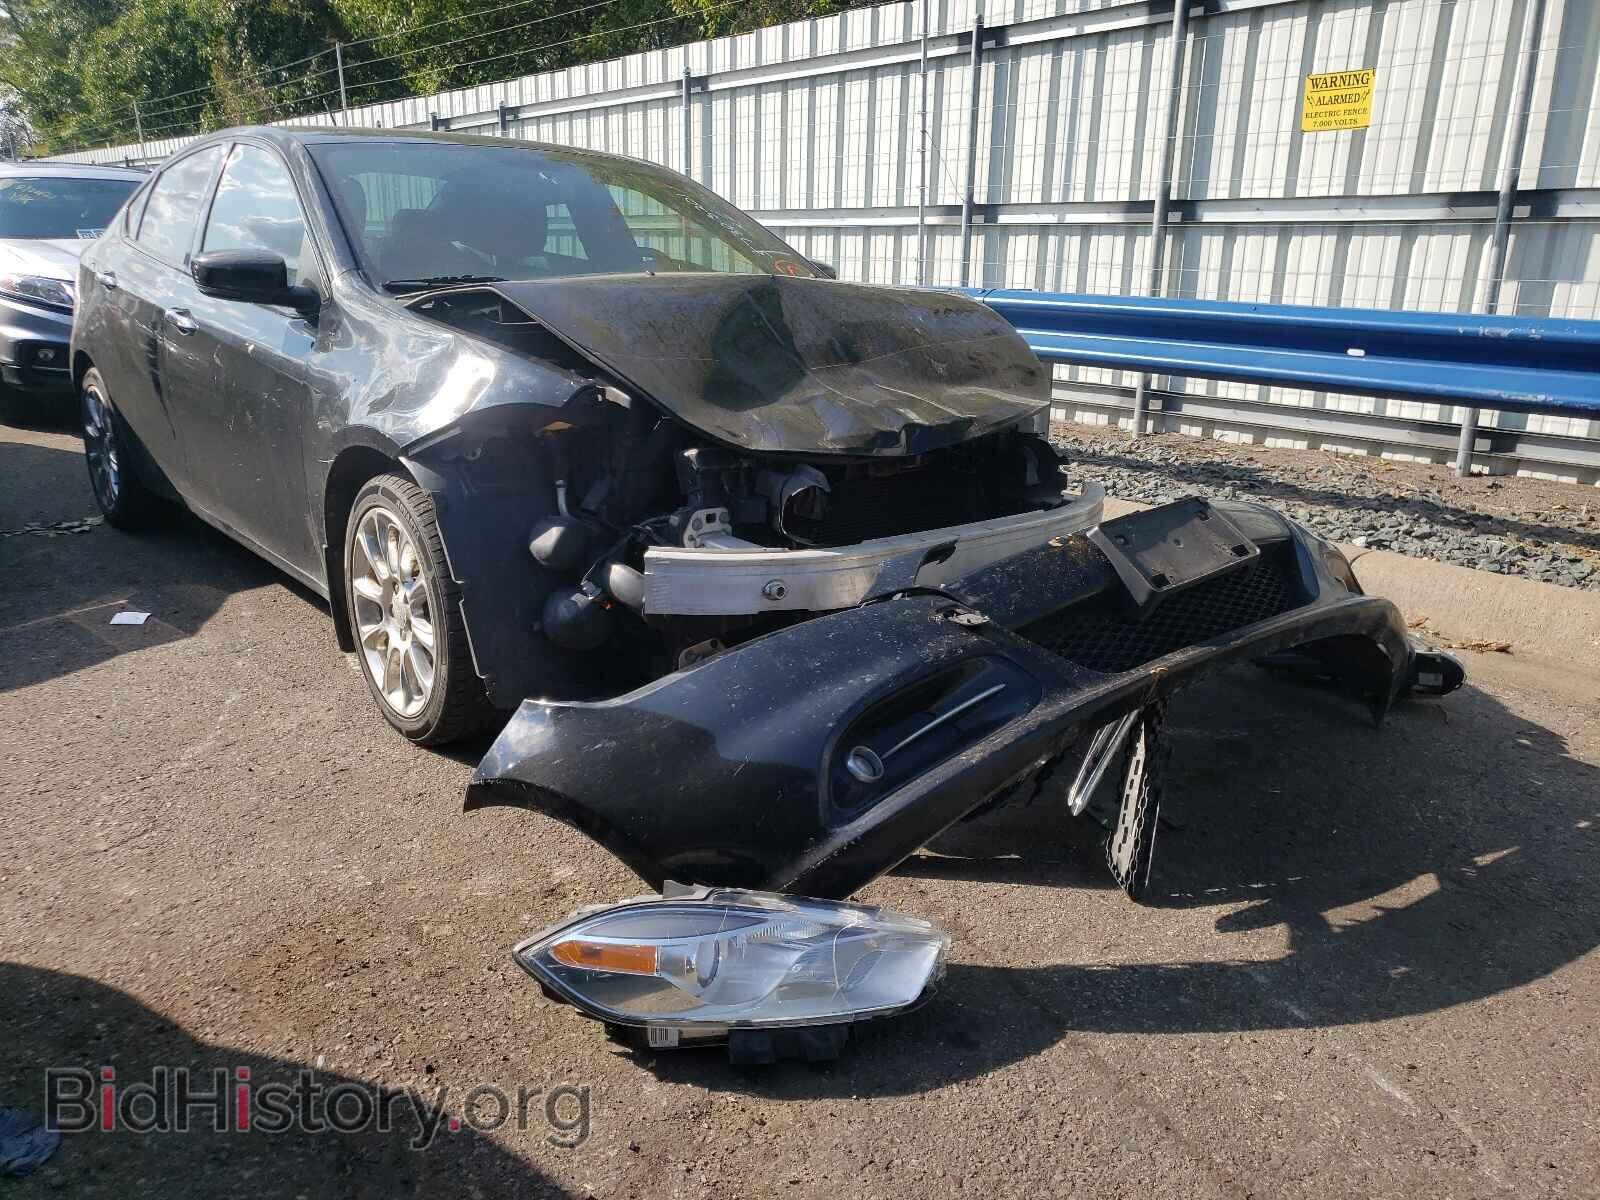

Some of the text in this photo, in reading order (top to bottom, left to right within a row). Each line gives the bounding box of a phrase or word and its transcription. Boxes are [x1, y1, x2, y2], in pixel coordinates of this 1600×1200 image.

[1309, 72, 1370, 90] WARNING
[1315, 92, 1360, 106] ALARMED
[1305, 107, 1368, 118] ELECTRIC FENCE
[1334, 118, 1358, 126] VOLTS
